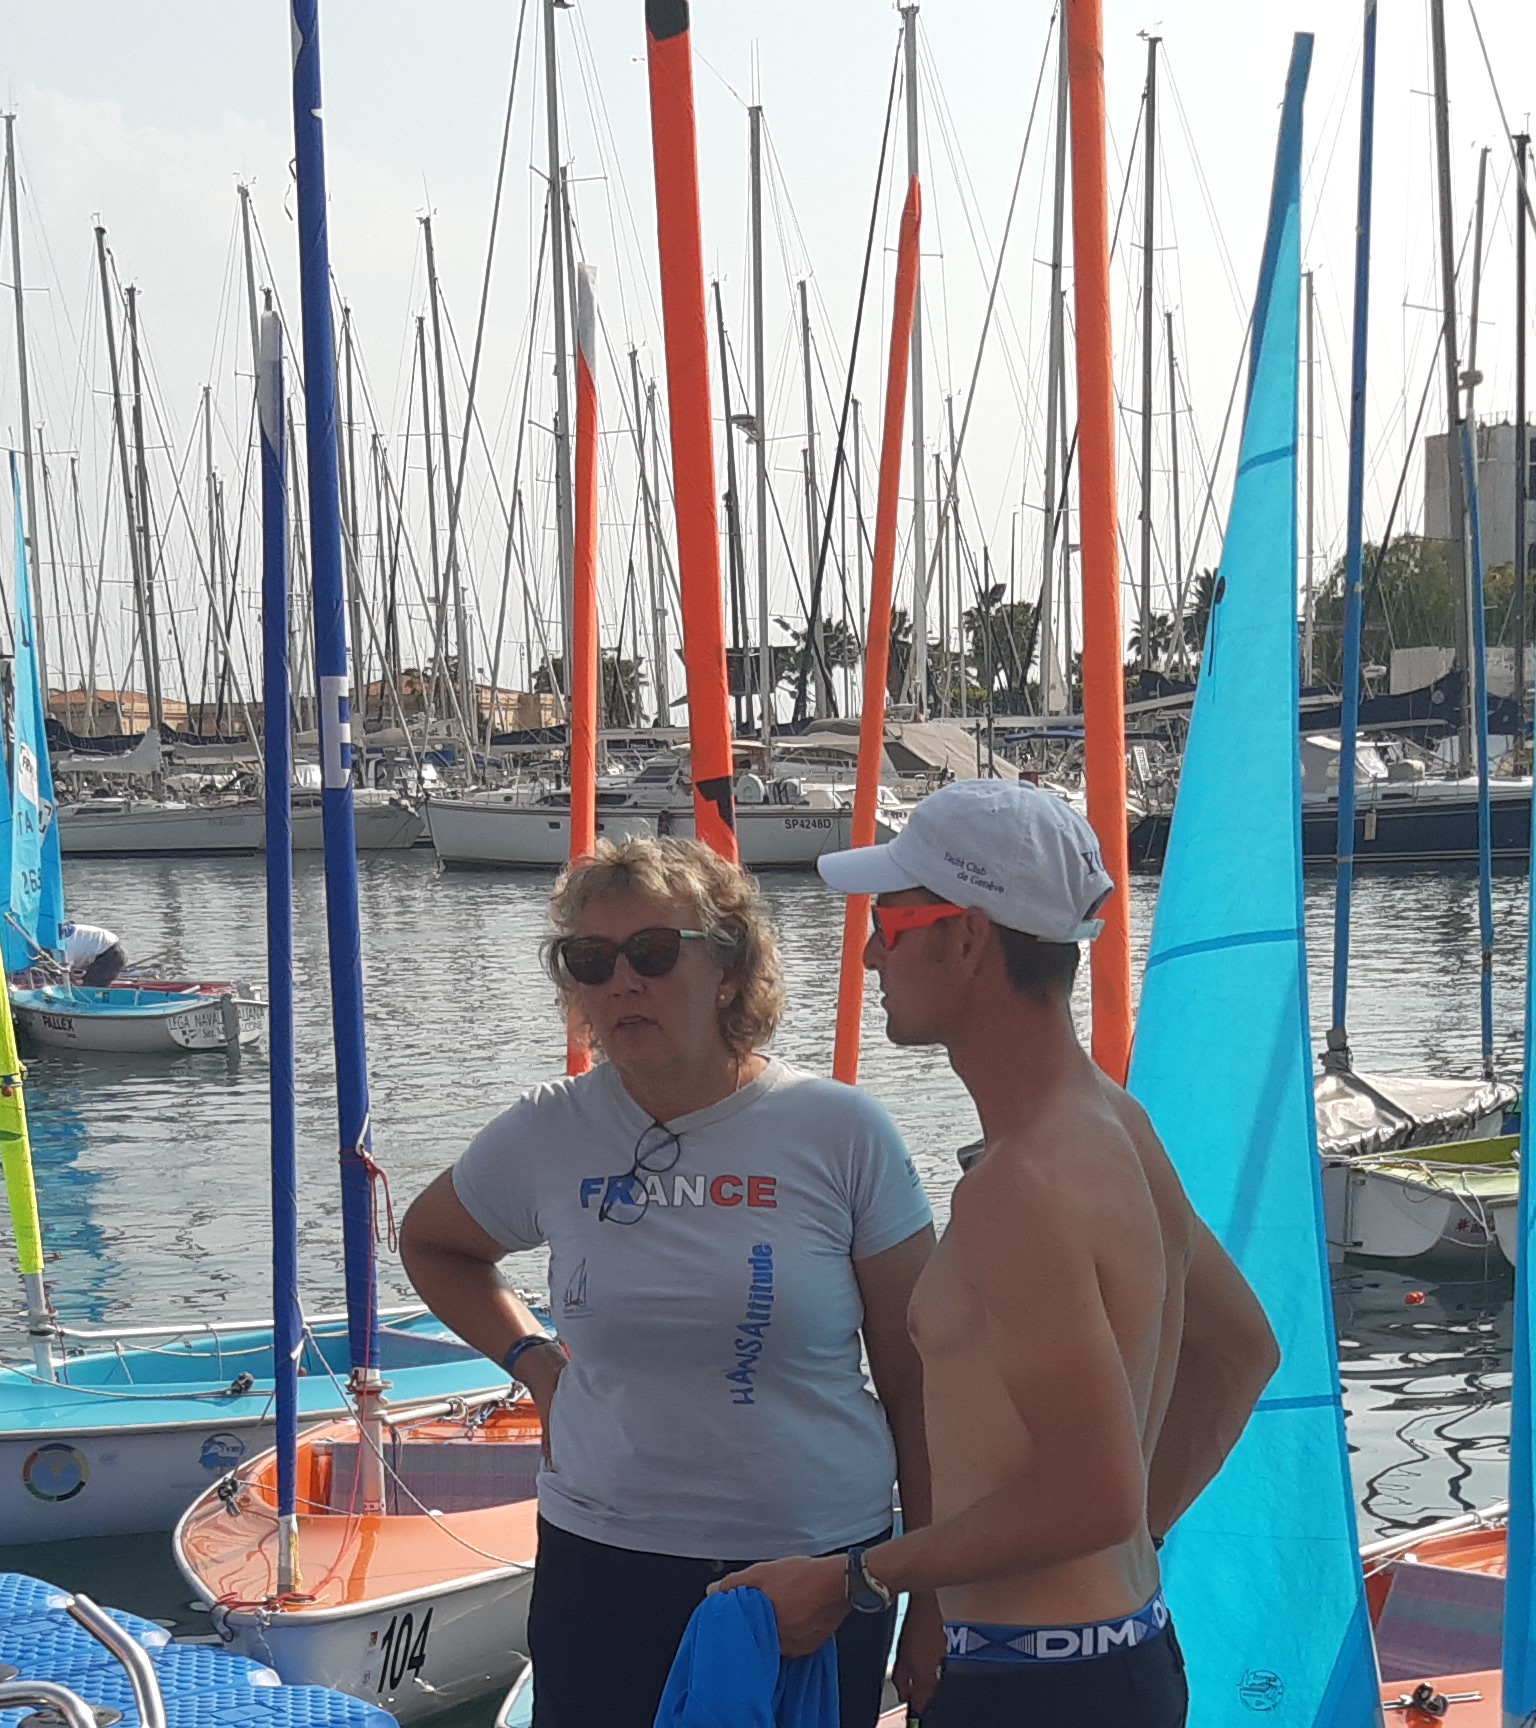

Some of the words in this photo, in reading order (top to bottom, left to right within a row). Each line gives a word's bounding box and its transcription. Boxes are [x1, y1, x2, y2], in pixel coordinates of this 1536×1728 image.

[580, 1174, 778, 1209] FRANCE
[377, 1606, 434, 1694] 104
[1036, 1619, 1137, 1659] DIM
